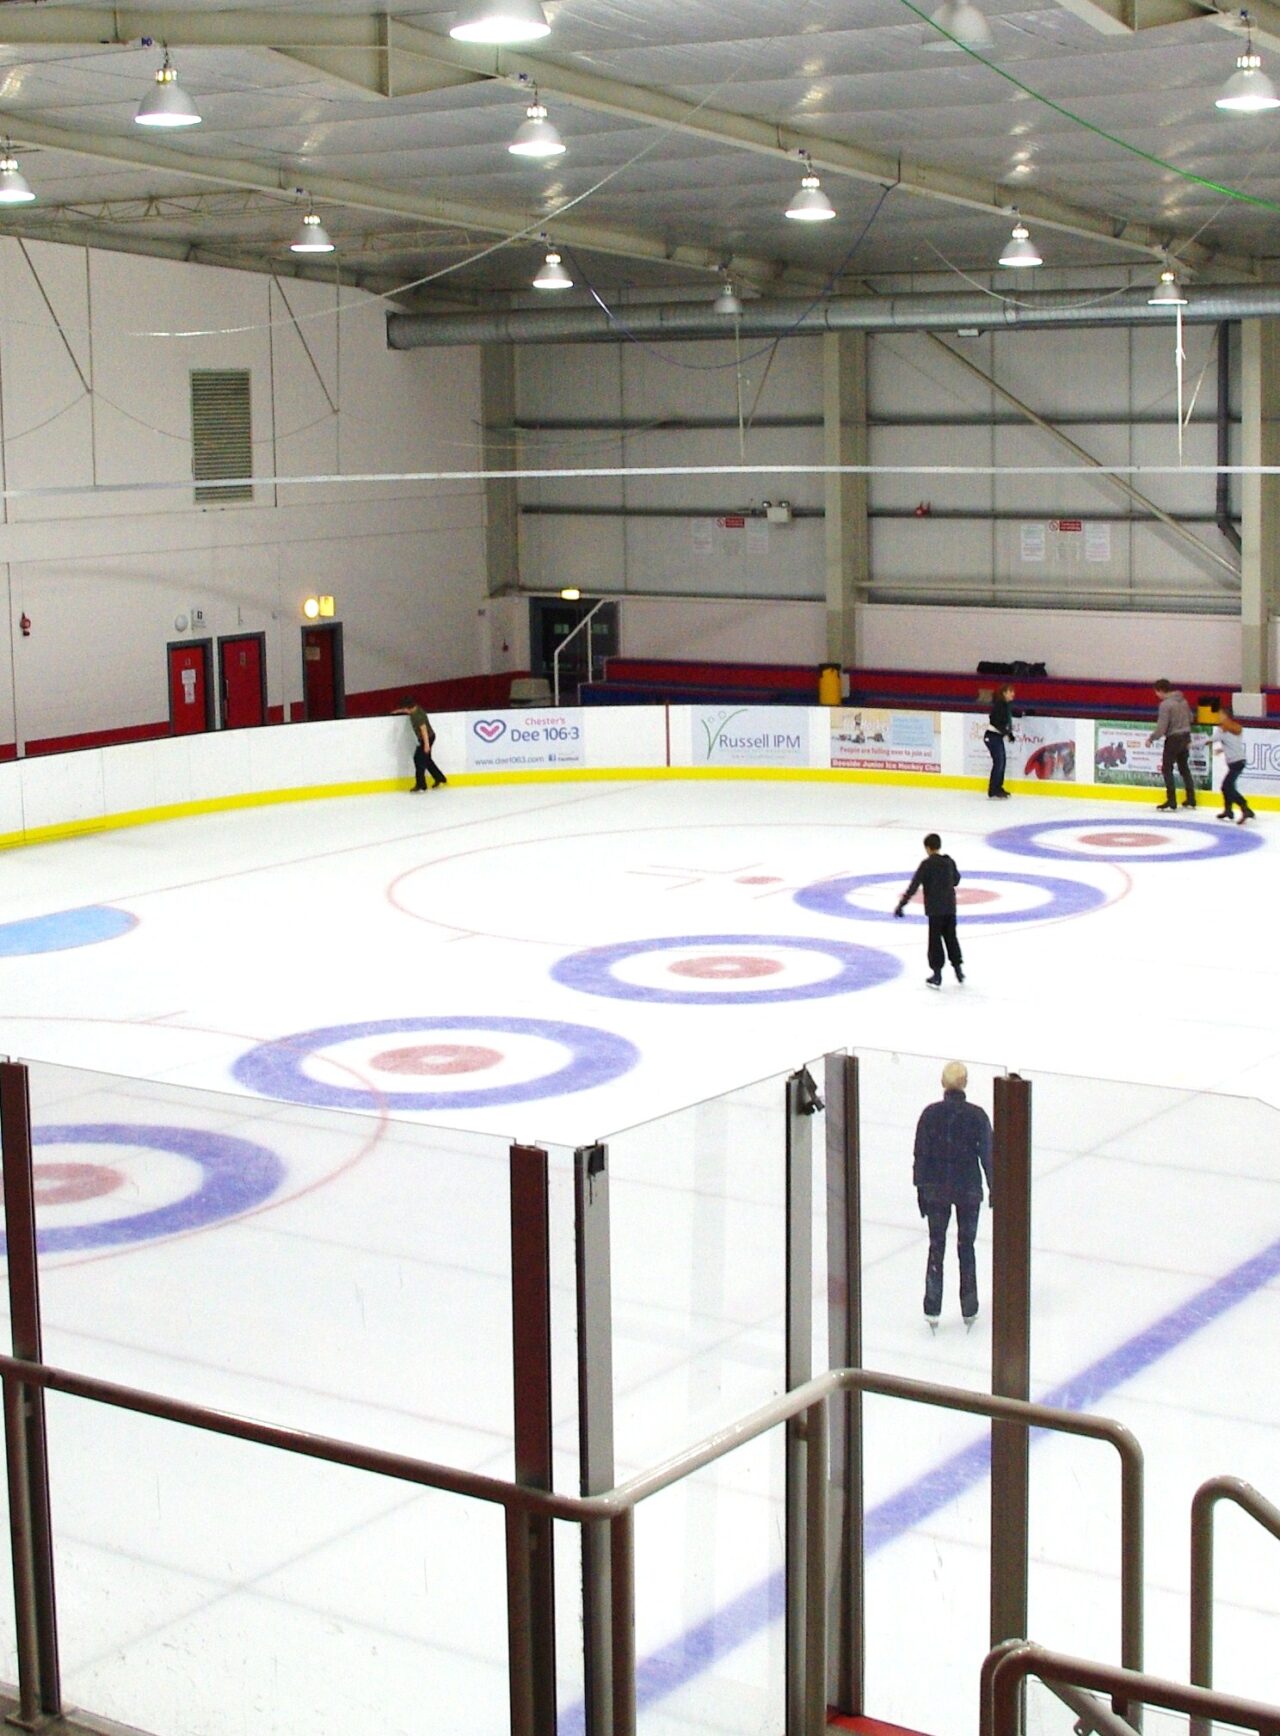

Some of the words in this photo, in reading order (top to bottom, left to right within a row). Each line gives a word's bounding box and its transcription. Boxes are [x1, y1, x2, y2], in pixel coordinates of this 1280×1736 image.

[524, 717, 566, 726] Chester's
[510, 728, 540, 742] Dee
[719, 734, 769, 748] Russell
[773, 734, 801, 748] IPM
